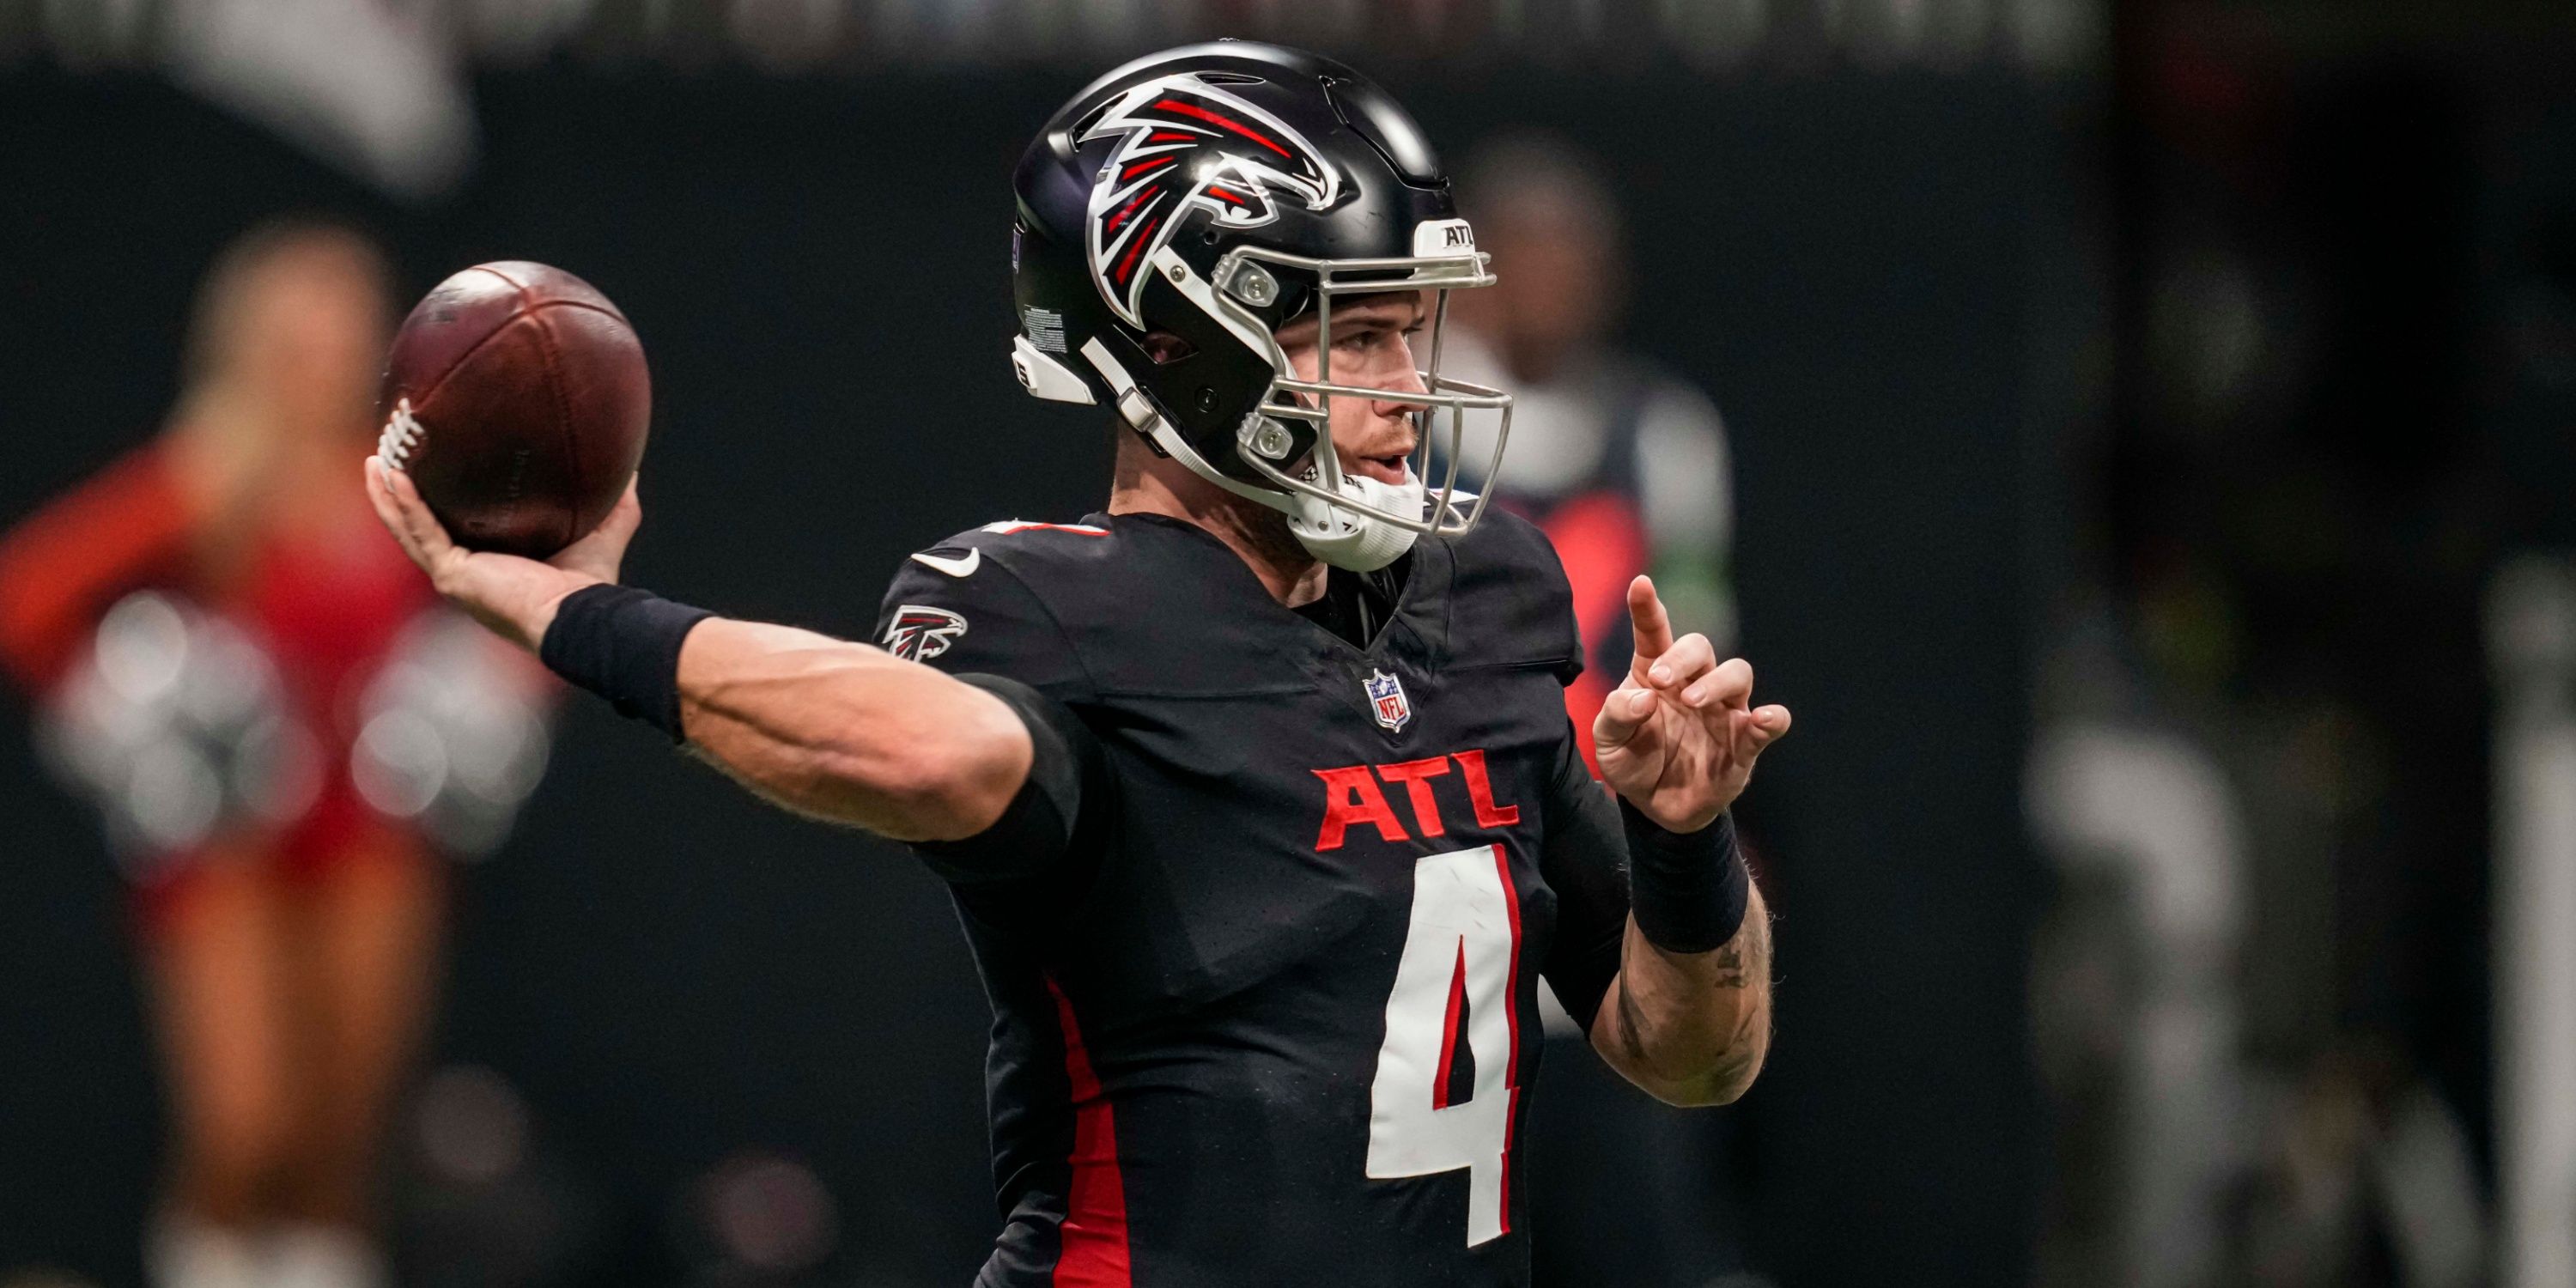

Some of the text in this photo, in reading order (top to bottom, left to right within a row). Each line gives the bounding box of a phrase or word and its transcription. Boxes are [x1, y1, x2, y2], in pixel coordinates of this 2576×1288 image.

[1444, 226, 1473, 246] ATL
[1377, 696, 1405, 720] NFL
[1310, 749, 1520, 851] ATL
[1366, 843, 1522, 1248] 4
